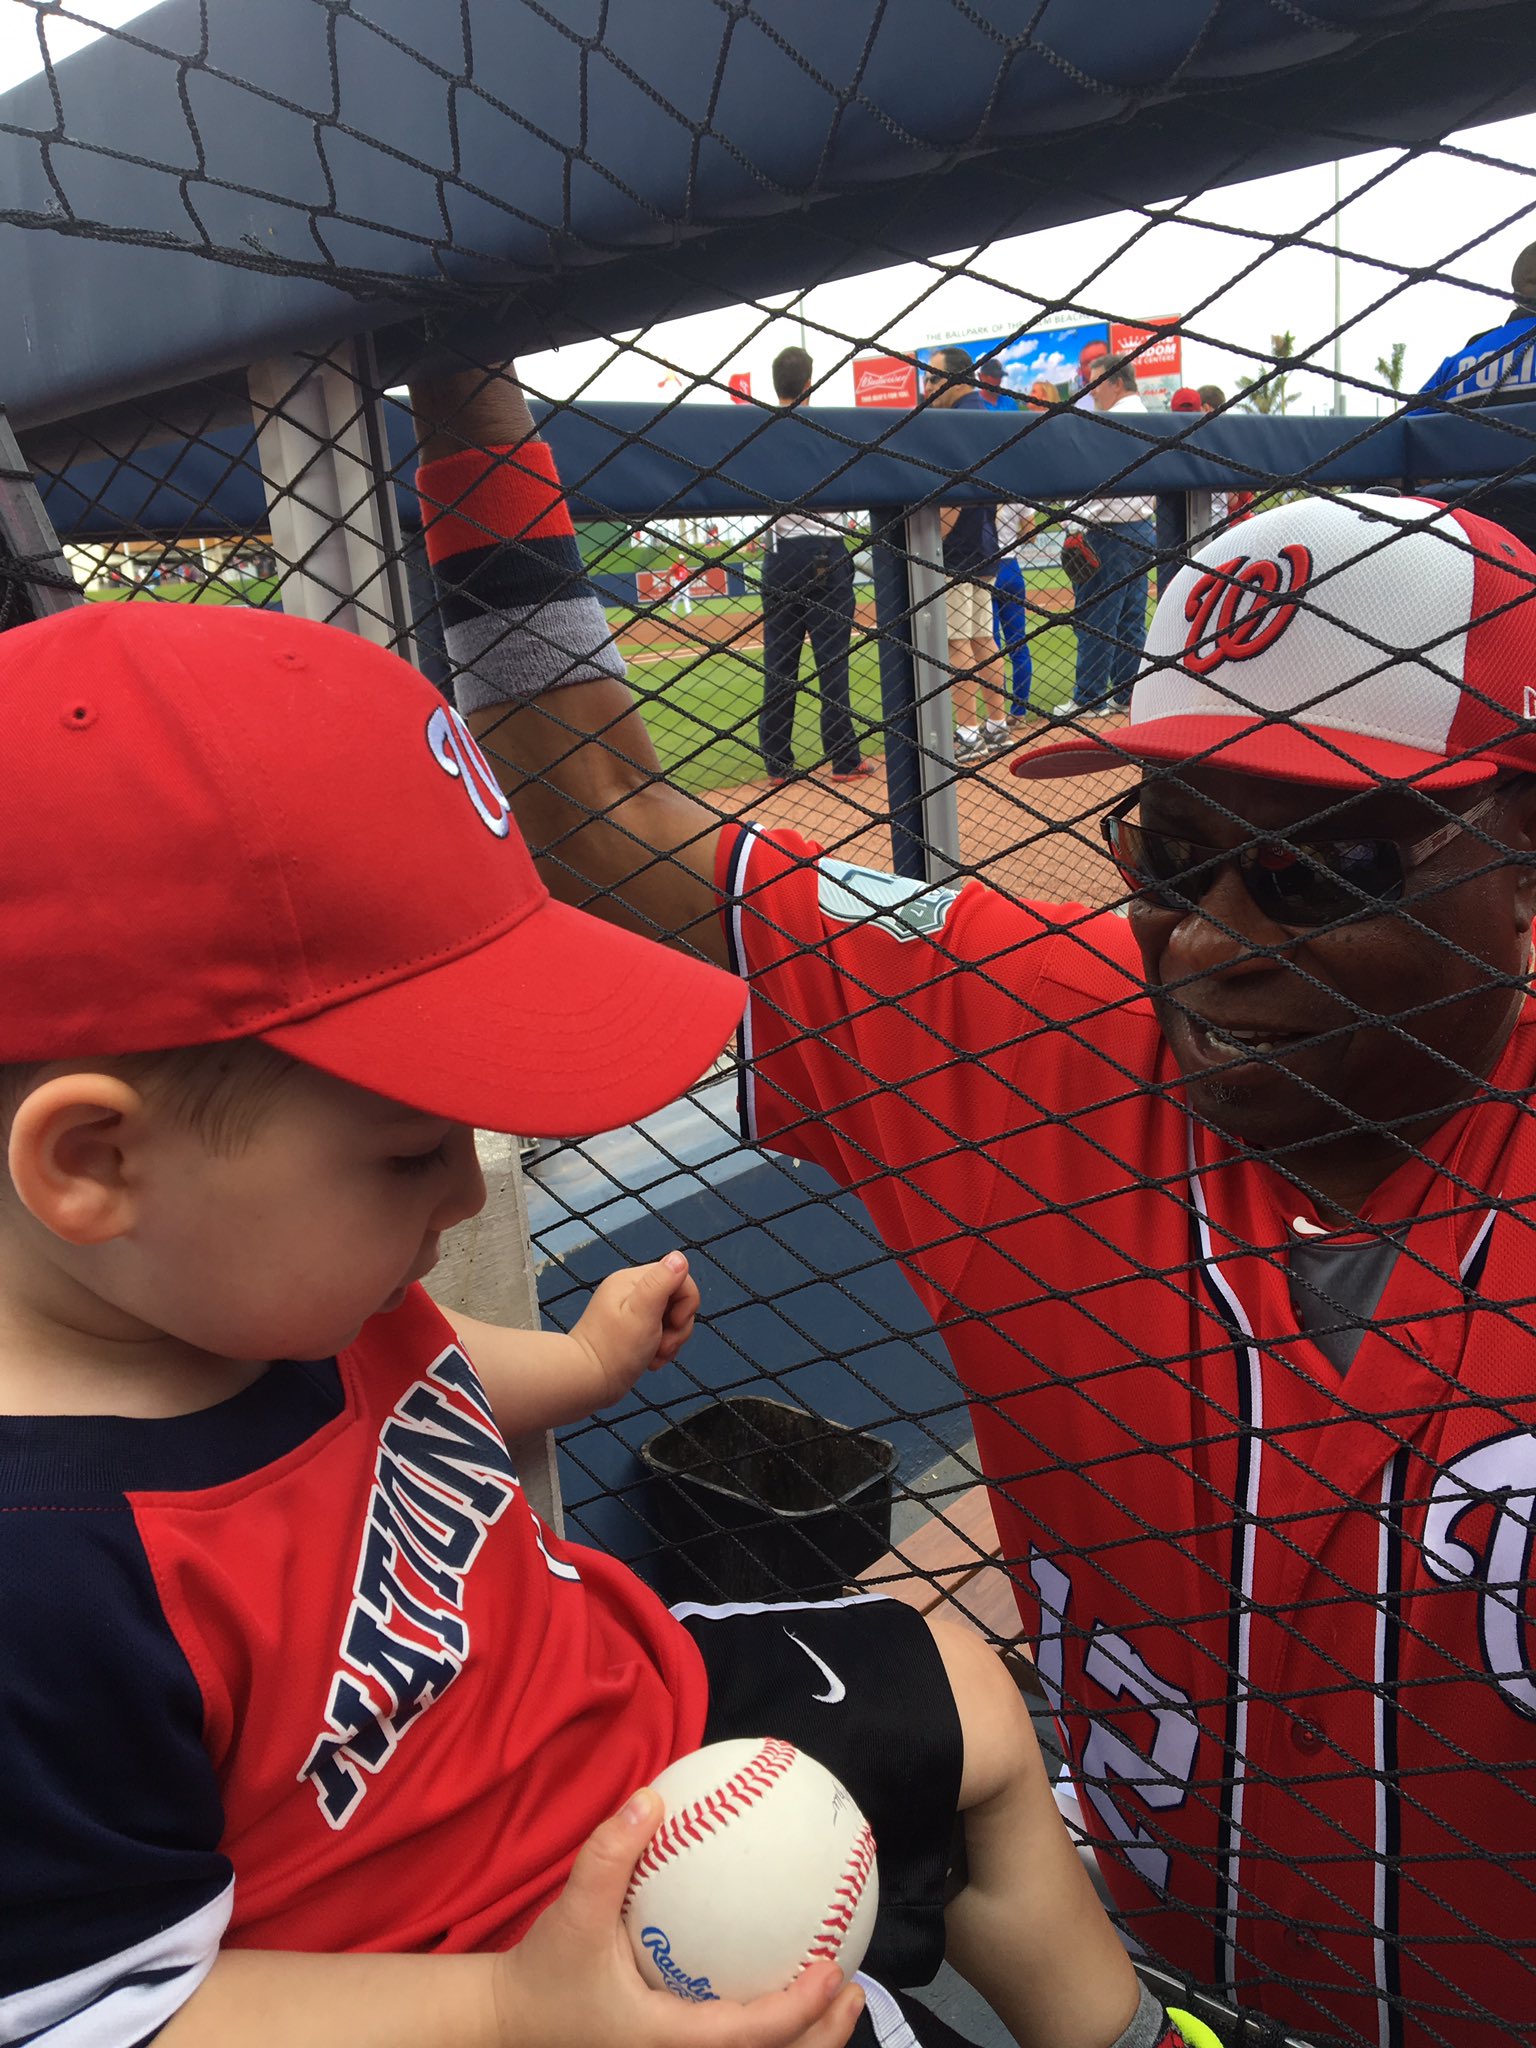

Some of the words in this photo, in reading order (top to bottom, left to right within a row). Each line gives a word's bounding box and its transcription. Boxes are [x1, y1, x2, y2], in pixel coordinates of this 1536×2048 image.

[945, 326, 989, 339] BALLPARK
[1455, 343, 1536, 395] POLI
[1183, 544, 1314, 675] W
